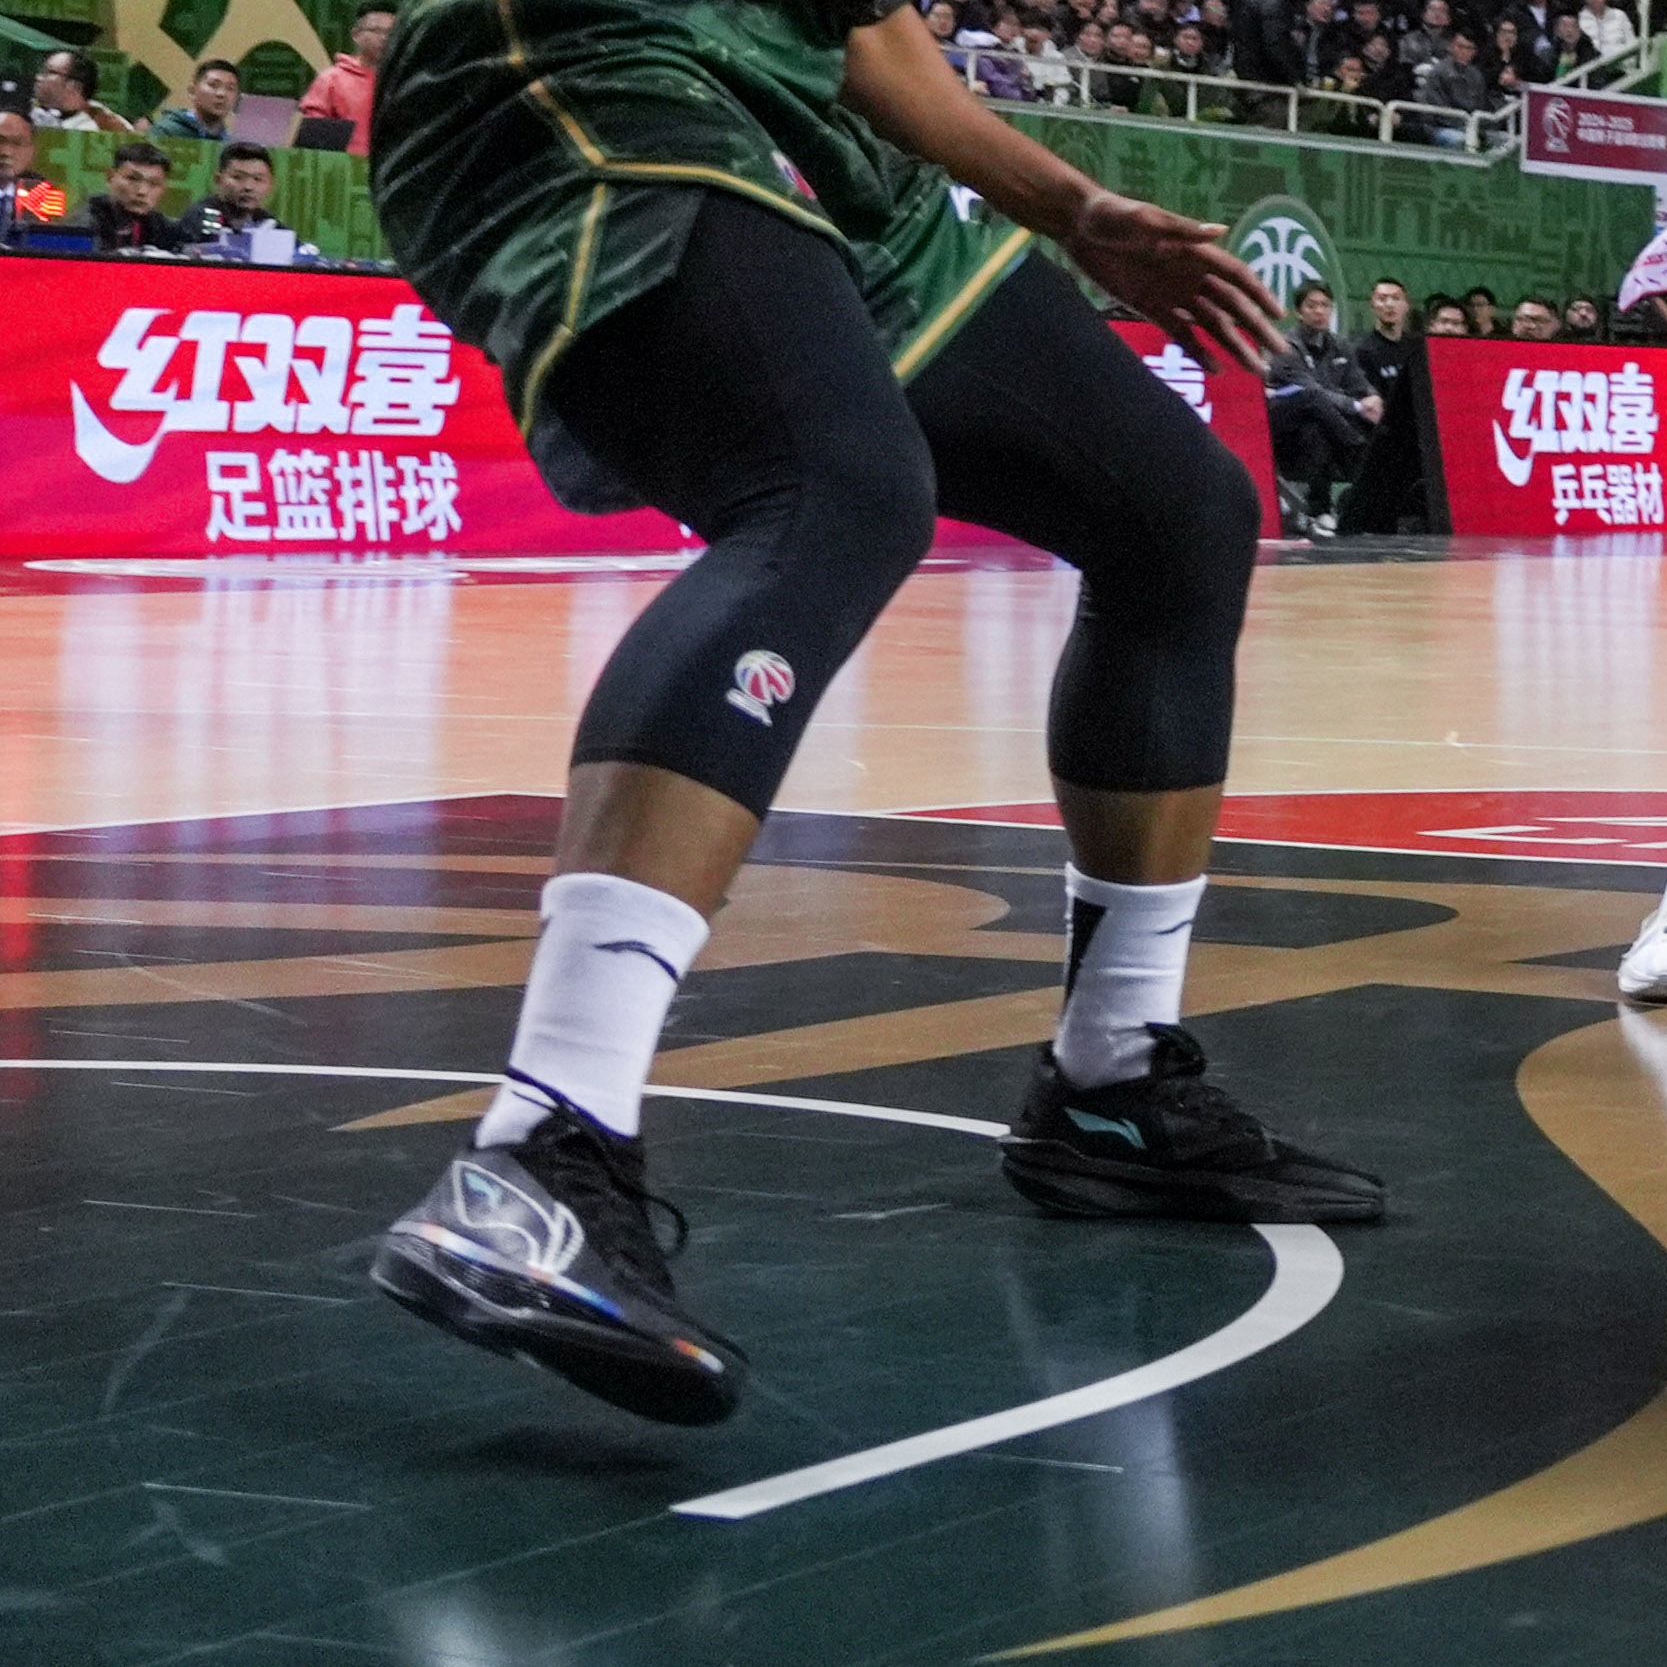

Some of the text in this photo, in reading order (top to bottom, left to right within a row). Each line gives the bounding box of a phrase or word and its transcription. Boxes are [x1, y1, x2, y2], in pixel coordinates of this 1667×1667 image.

[97, 304, 461, 437] 红双喜
[1502, 361, 1660, 454] 红双喜
[205, 449, 463, 542] 足篮排球
[1551, 461, 1666, 526] 乒乓器材
